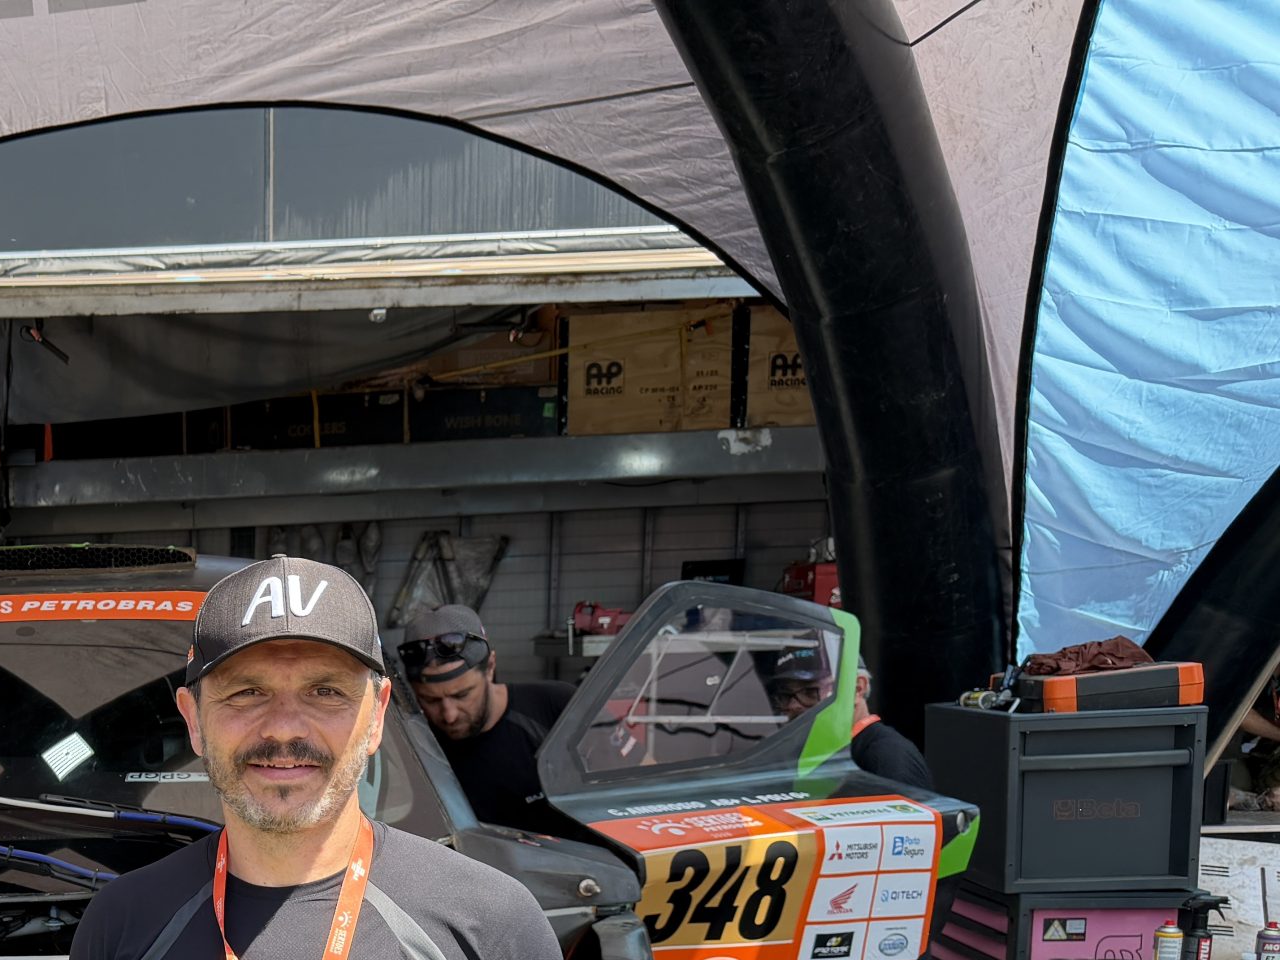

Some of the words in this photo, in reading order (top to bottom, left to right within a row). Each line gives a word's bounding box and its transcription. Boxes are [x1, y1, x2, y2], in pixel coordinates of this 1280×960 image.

[585, 386, 623, 396] RACING
[21, 599, 194, 613] PETROBRAS
[241, 574, 329, 628] AV
[643, 840, 799, 944] 348
